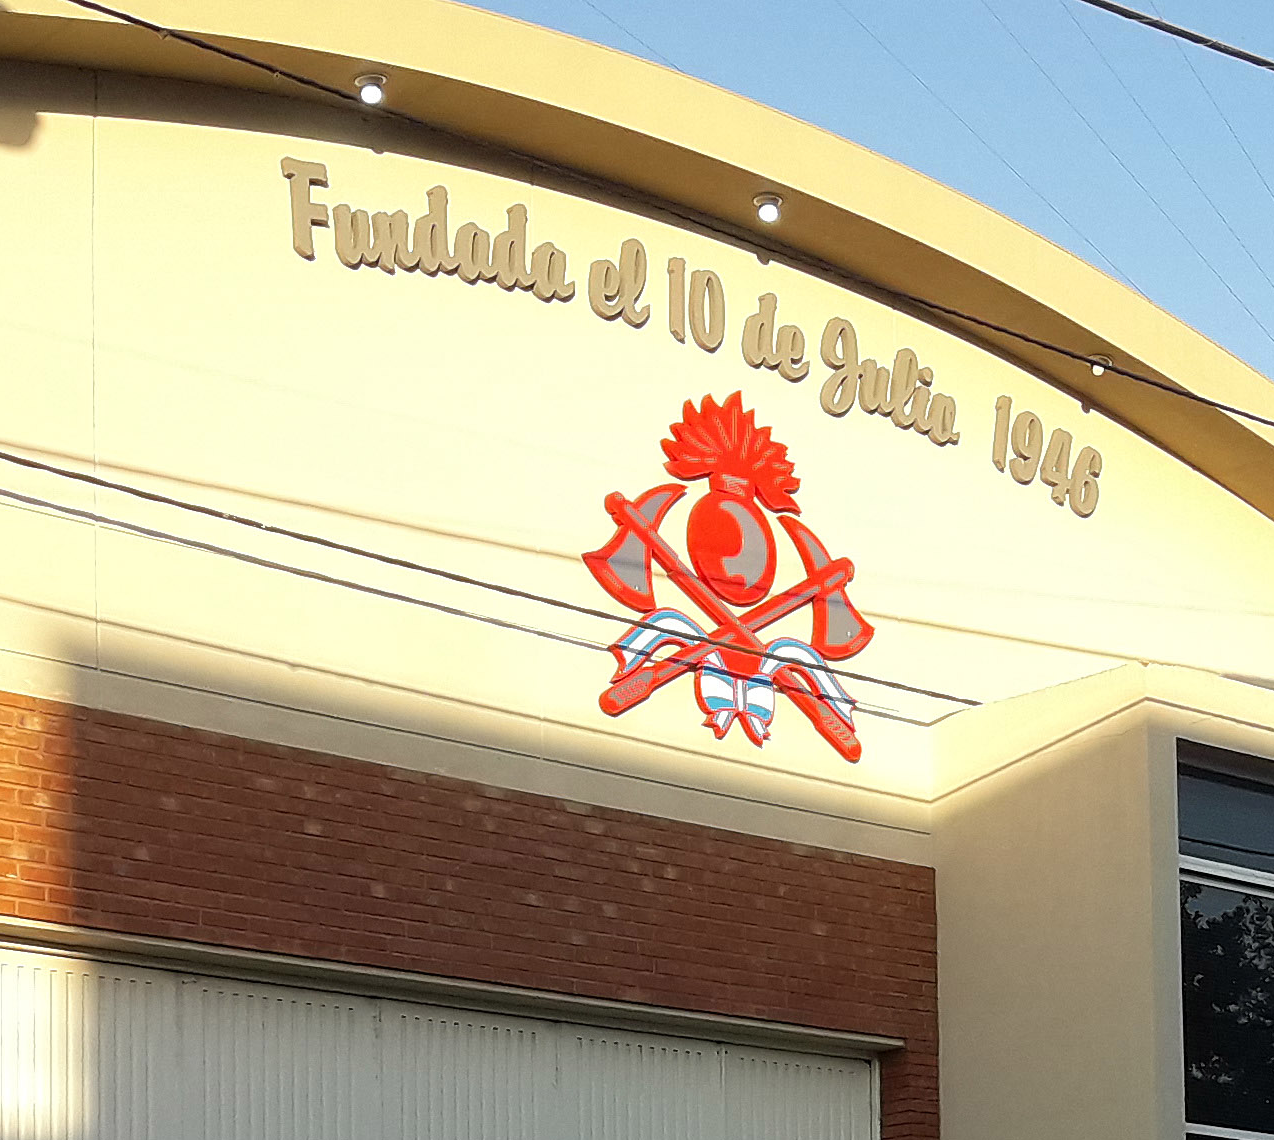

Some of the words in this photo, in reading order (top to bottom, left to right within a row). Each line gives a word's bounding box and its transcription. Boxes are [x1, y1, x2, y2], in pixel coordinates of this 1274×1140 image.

[280, 157, 575, 302] Fundada
[588, 238, 651, 328] el
[667, 256, 726, 350] 10
[741, 293, 811, 382] de
[819, 317, 960, 446] Julio
[991, 395, 1103, 518] 1946
